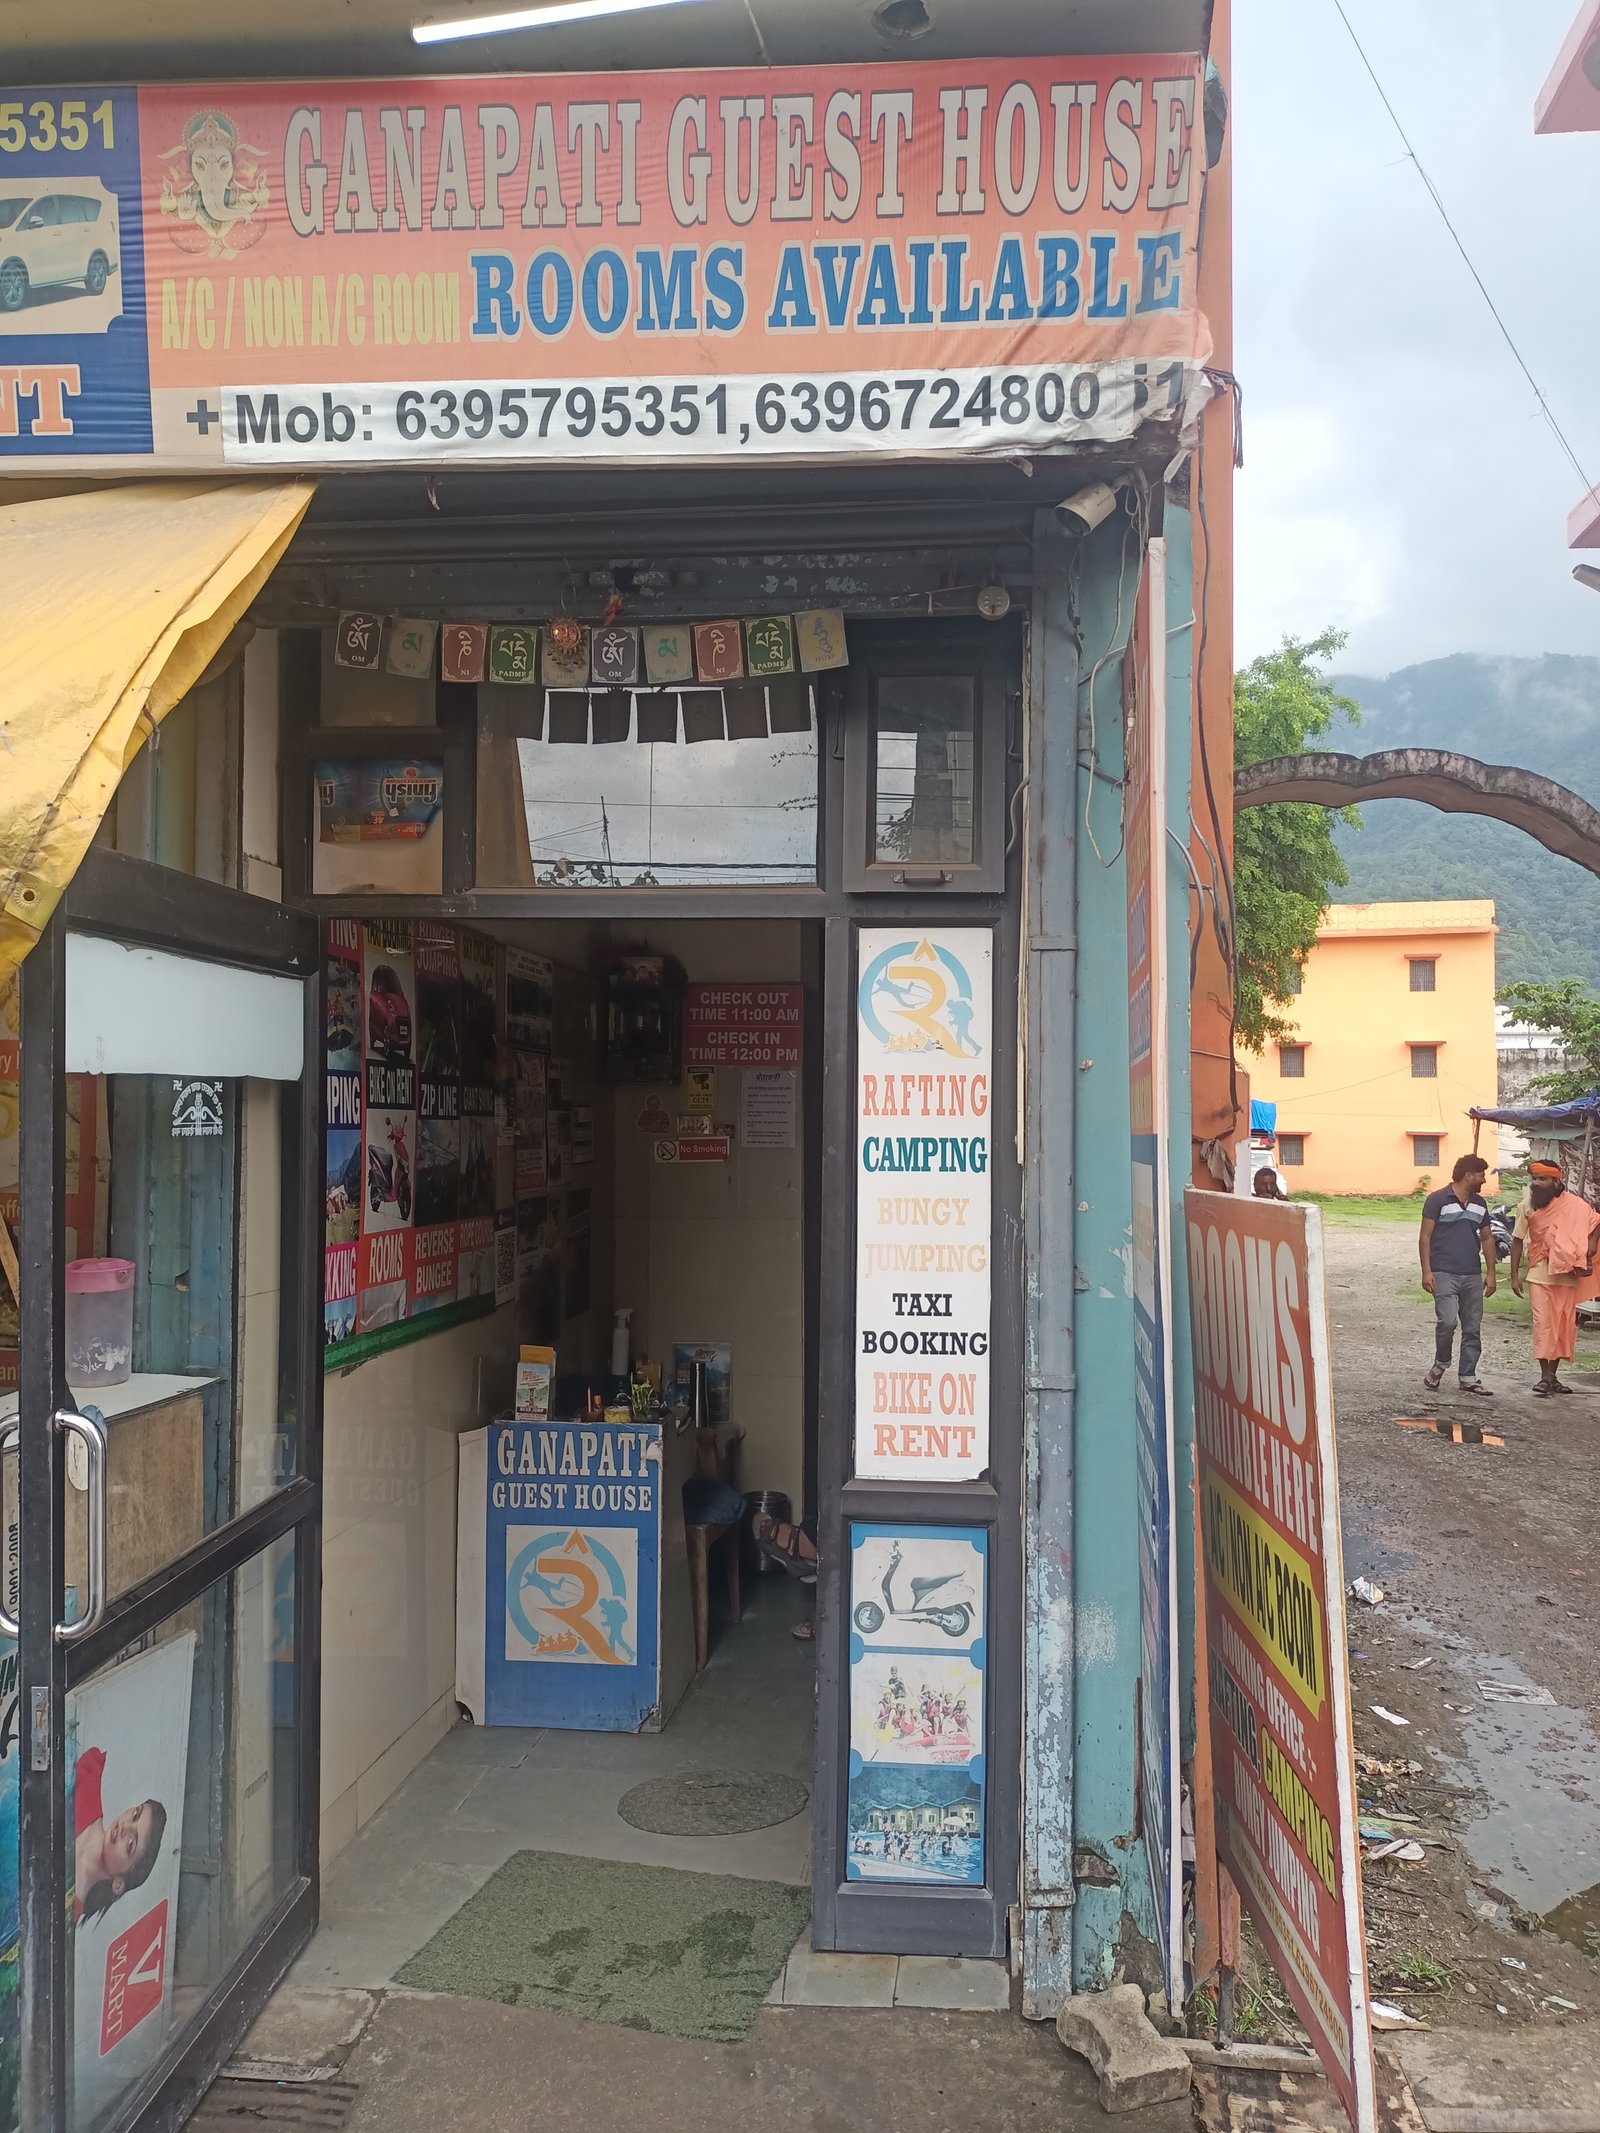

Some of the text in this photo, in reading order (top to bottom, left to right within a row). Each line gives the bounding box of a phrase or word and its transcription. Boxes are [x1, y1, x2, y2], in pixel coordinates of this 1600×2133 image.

[0, 99, 115, 152] 5351
[283, 76, 1196, 237] GANAPATI GUEST HOUSE
[470, 230, 1182, 337] ROOMS AVAILABLE
[244, 274, 302, 349] NON
[310, 272, 366, 347] A/C
[374, 270, 460, 345] ROOM
[237, 388, 373, 445] Mob:
[394, 373, 1100, 444] 6395795351,6396724800
[351, 655, 365, 663] OM
[460, 668, 470, 676] NI
[498, 669, 527, 678] PADME
[608, 670, 622, 678] OM
[756, 660, 785, 670] PADME
[385, 783, 437, 803] finish
[417, 950, 458, 978] JUMPING
[689, 1008, 799, 1022] TIME 11:00 AM
[700, 992, 789, 1006] CHECK OUT
[689, 1047, 798, 1061] TIME 12:00 PM
[706, 1031, 781, 1045] CHECK IN
[370, 1066, 413, 1105] BIKE ON RENT
[421, 1084, 458, 1117] ZIP LINE
[862, 1073, 988, 1117] RAFTING
[680, 1144, 727, 1155] No Smoking
[862, 1135, 988, 1174] CAMPING
[877, 1197, 969, 1227] BUNGY
[369, 1231, 404, 1285] ROOMS
[415, 1227, 455, 1261] REVERSE
[865, 1243, 988, 1280] JUMPING
[416, 1259, 453, 1294] BUNGEE
[892, 1291, 953, 1317] TAXI
[862, 1329, 988, 1356] BOOKING
[1188, 1221, 1307, 1445] ROOMS
[873, 1370, 977, 1416] BIKE ON
[497, 1427, 649, 1479] GANAPATI
[873, 1422, 977, 1459] RENT
[1198, 1381, 1270, 1510] AVAILABLE
[1271, 1434, 1318, 1555] HERE
[492, 1481, 652, 1512] GUEST HOUSE
[1229, 1504, 1255, 1617] NON
[1255, 1532, 1274, 1642] A/C
[1274, 1551, 1318, 1697] ROOM
[1221, 1613, 1265, 1713] BOOKING
[1265, 1675, 1305, 1762] OFFICE
[1261, 1723, 1338, 1903] CAMPING
[1232, 1750, 1321, 1958] BUNGY JUMPING
[127, 1926, 163, 1986] V
[105, 1940, 129, 2040] MART
